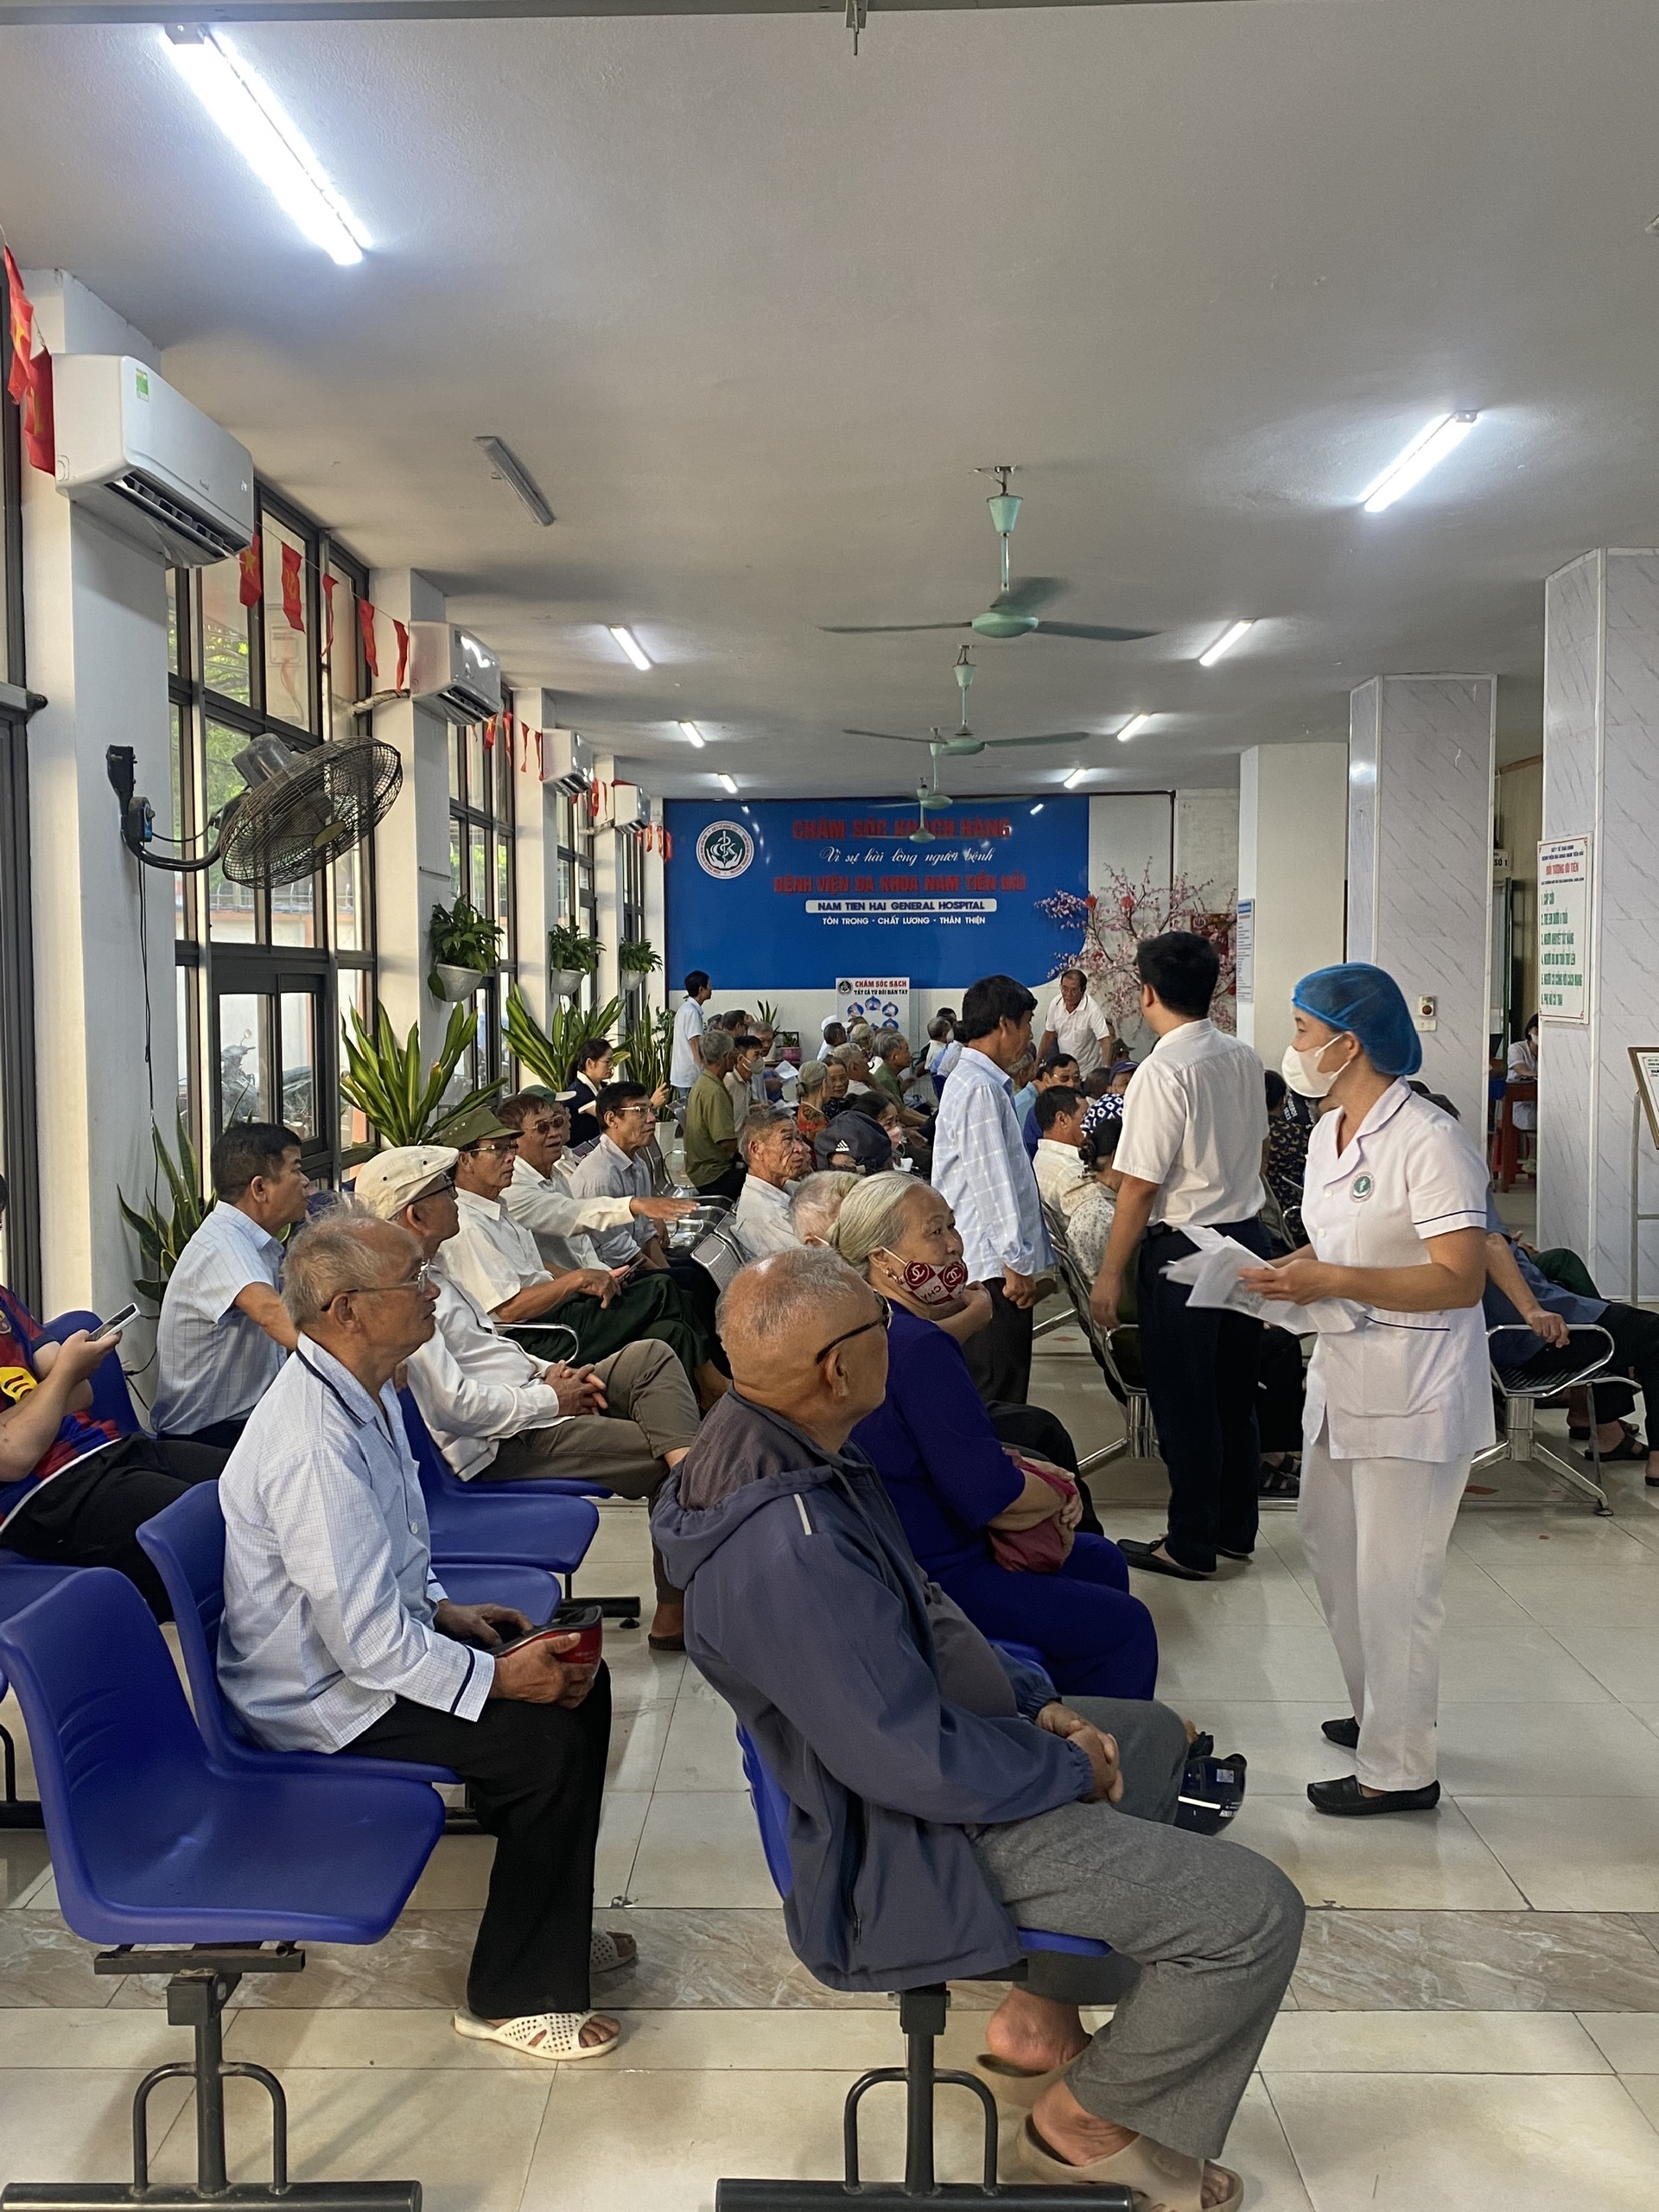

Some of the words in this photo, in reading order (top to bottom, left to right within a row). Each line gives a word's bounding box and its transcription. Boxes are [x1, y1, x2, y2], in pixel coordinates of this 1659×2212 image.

[853, 816, 887, 837] SÓC
[820, 846, 841, 862] Vì
[845, 852, 860, 865] sự
[863, 848, 884, 862] hài
[925, 850, 958, 866] người
[963, 847, 995, 863] bệnh
[924, 874, 959, 892] NAM
[817, 902, 842, 911] NAM
[845, 902, 866, 911] TIEN
[869, 902, 887, 911] HAI
[891, 901, 935, 910] GENERAL
[938, 900, 985, 910] HOSPITAL
[823, 916, 839, 925] TÔN
[877, 914, 899, 925] CHẤT
[939, 915, 962, 925] THÂN
[965, 915, 986, 925] THIỆN
